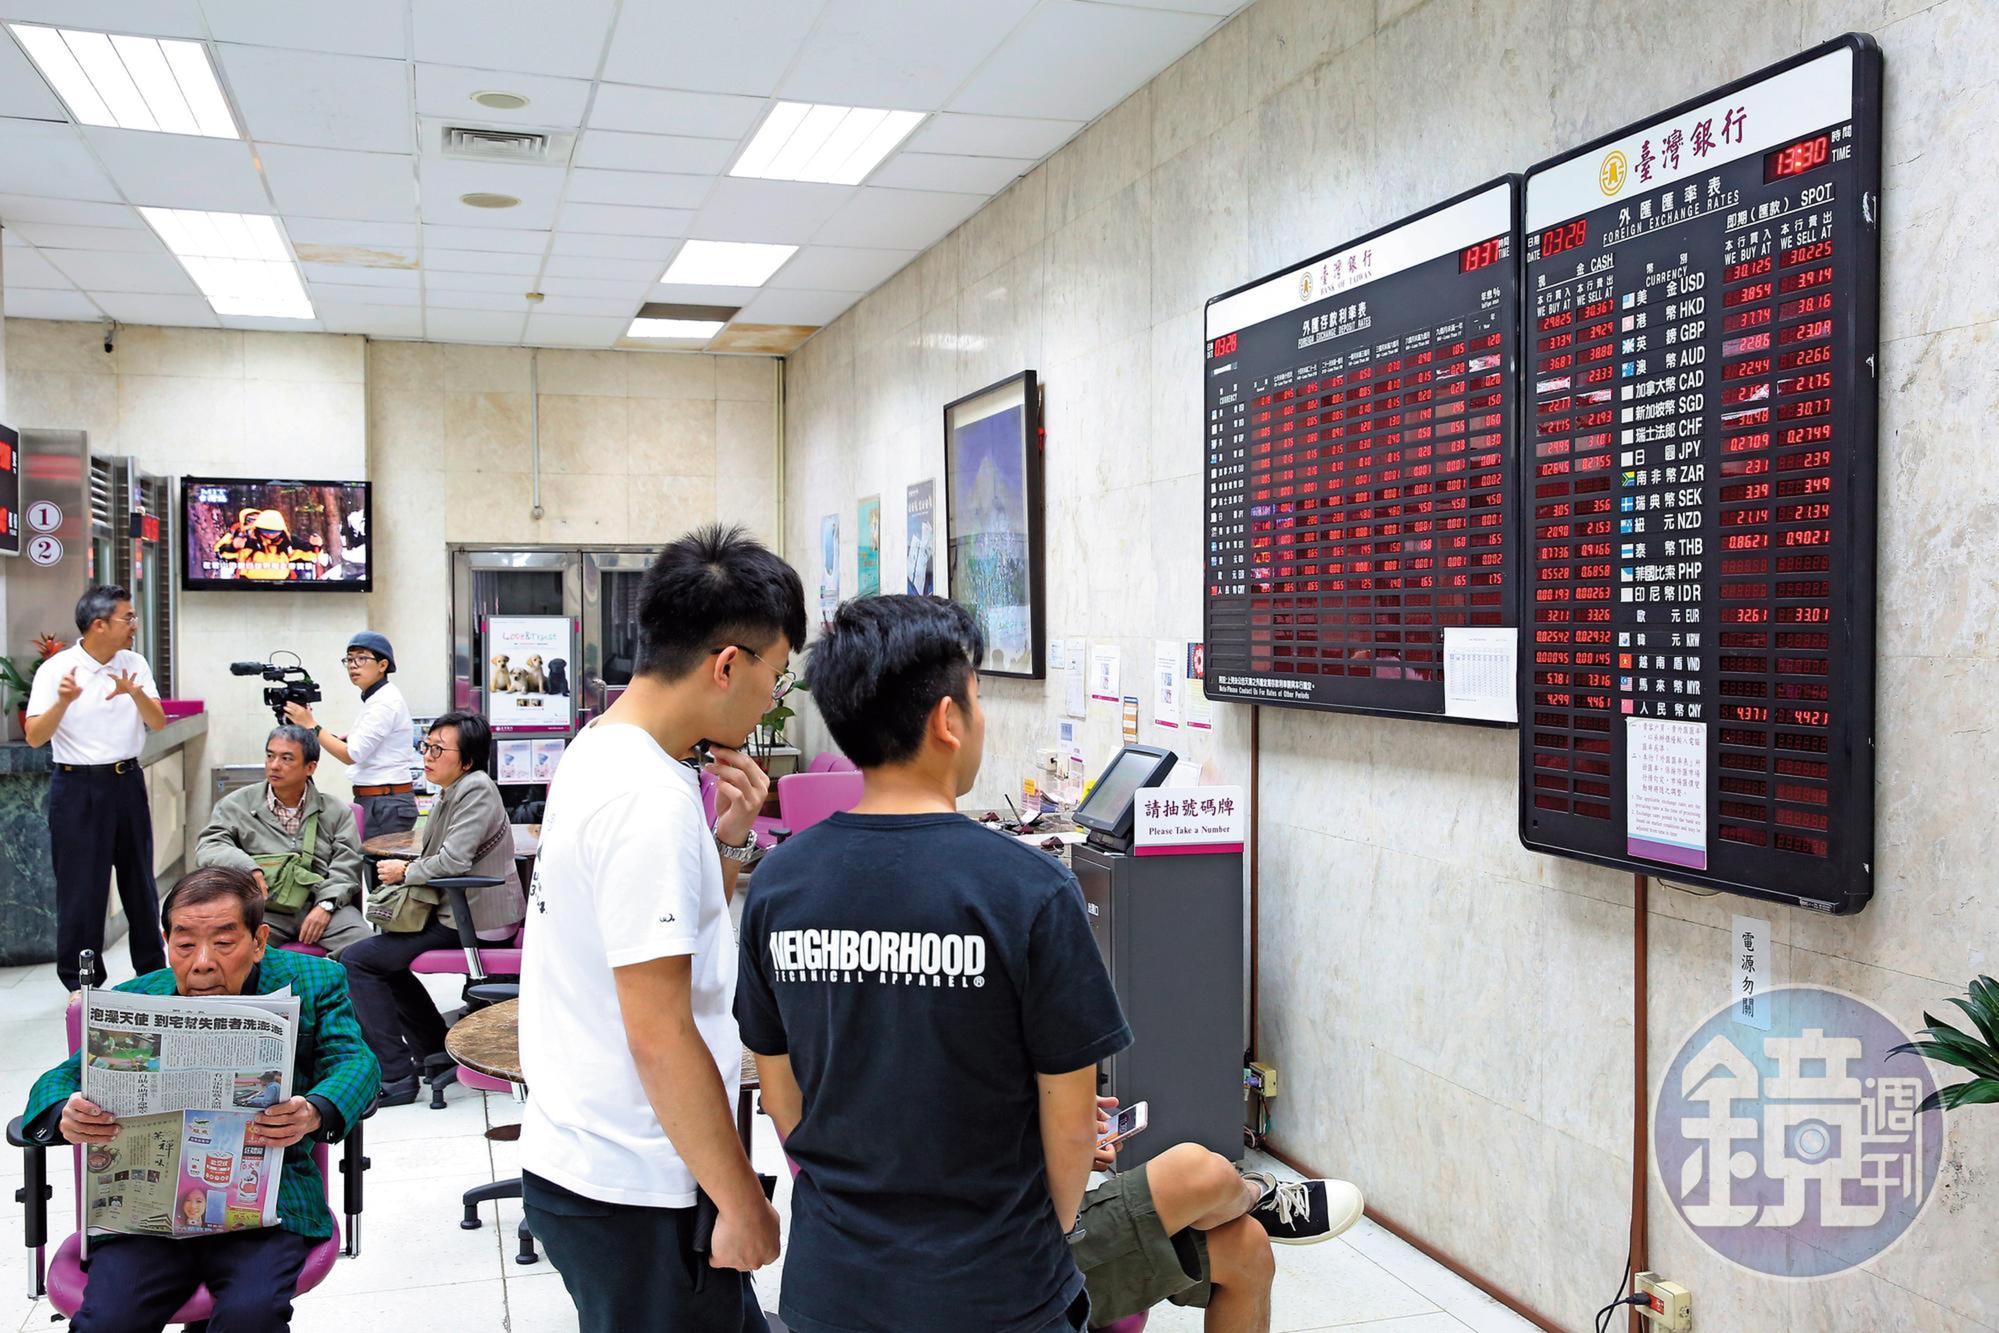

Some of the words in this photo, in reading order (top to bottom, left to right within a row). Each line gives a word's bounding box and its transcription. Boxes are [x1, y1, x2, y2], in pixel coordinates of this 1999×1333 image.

[1832, 124, 1852, 143] 時間
[1634, 105, 1748, 184] 臺灣銀行
[1832, 145, 1851, 163] TIME
[1800, 182, 1832, 205] SPOT
[1603, 221, 1642, 244] FOREIGN
[1649, 203, 1700, 230] EXCHANGE
[1707, 190, 1740, 209] RATES
[1527, 235, 1540, 249] 日期
[1724, 254, 1737, 265] WE
[1741, 248, 1756, 260] BUY
[1761, 242, 1772, 255] AT
[1780, 237, 1793, 250] WE
[1796, 231, 1816, 245] SELL
[1821, 225, 1833, 239] AT
[1527, 248, 1541, 263] DATE
[1590, 252, 1614, 272] CASH
[1321, 249, 1372, 285] 臺灣銀行
[1645, 266, 1688, 288] CURRENCY
[1680, 271, 1705, 294] USD
[1537, 306, 1546, 317] WE
[1549, 303, 1560, 315] BUY
[1563, 299, 1571, 310] AT
[1576, 295, 1586, 306] WE
[1588, 290, 1602, 303] SELL
[1604, 286, 1614, 298] AT
[1680, 296, 1705, 318] HKD
[1680, 320, 1705, 342] GBP
[1680, 346, 1705, 368] AUD
[1679, 369, 1704, 390] CAD
[1678, 393, 1704, 413] SGD
[1678, 417, 1703, 437] CHF
[1678, 439, 1701, 460] JPY
[1680, 464, 1705, 483] ZAR
[1678, 487, 1703, 507] SEK
[1677, 510, 1702, 530] NZD
[1679, 538, 1703, 555] THB
[1678, 562, 1702, 580] PHP
[1678, 585, 1701, 602] IDR
[1685, 608, 1700, 623] EUR
[1686, 632, 1700, 647] KRW
[1686, 656, 1700, 672] VND
[1686, 680, 1701, 695] MYR
[1688, 703, 1701, 718] CNY
[1144, 797, 1234, 818] 請抽號碼牌
[1149, 827, 1173, 836] Please
[1175, 826, 1192, 835] Take
[1201, 825, 1230, 834] Number
[769, 928, 985, 976] NEIGHBORHOOD
[775, 970, 864, 983] TECHNICAL
[879, 974, 969, 988] APPAREL
[1741, 931, 1756, 1018] 電源勿關
[90, 1007, 149, 1027] 泡澡天使
